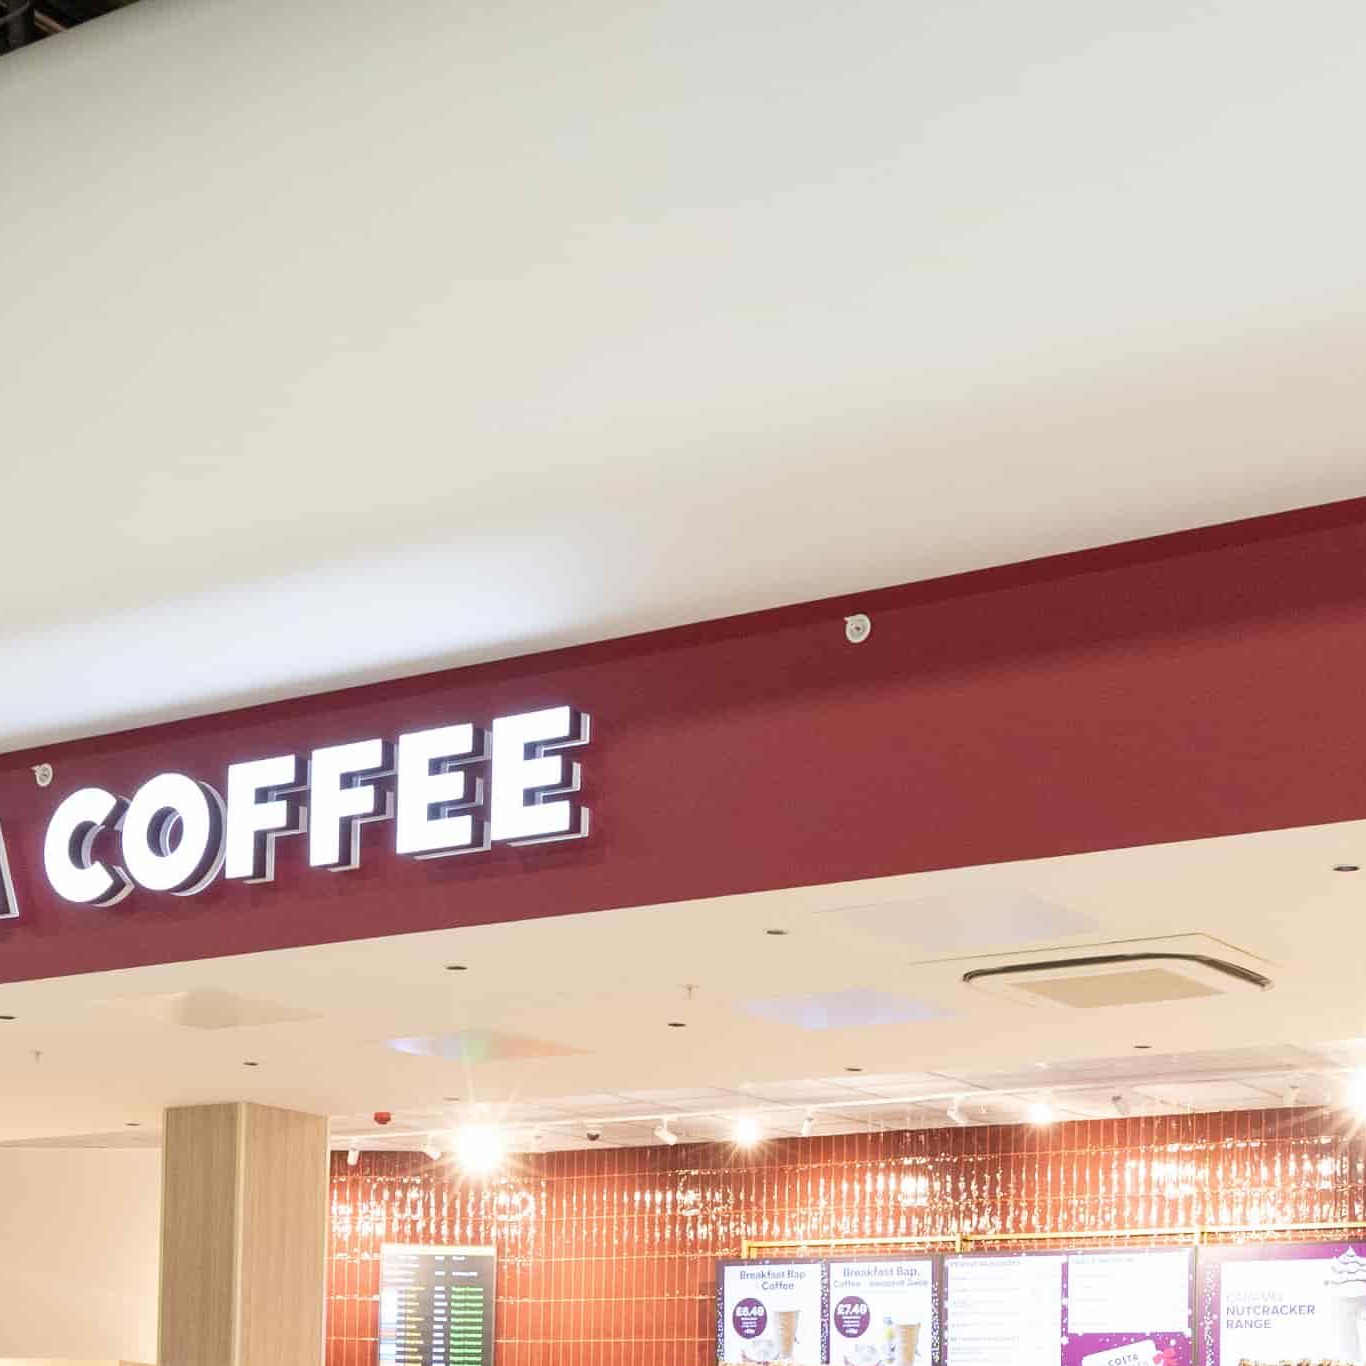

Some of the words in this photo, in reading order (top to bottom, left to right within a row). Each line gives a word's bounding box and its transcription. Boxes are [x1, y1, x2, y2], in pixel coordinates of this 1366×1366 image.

[43, 704, 591, 908] COFFEE
[761, 1281, 795, 1290] Coffee
[1226, 1304, 1315, 1316] NUTCRACKER
[1226, 1319, 1273, 1329] RANGE
